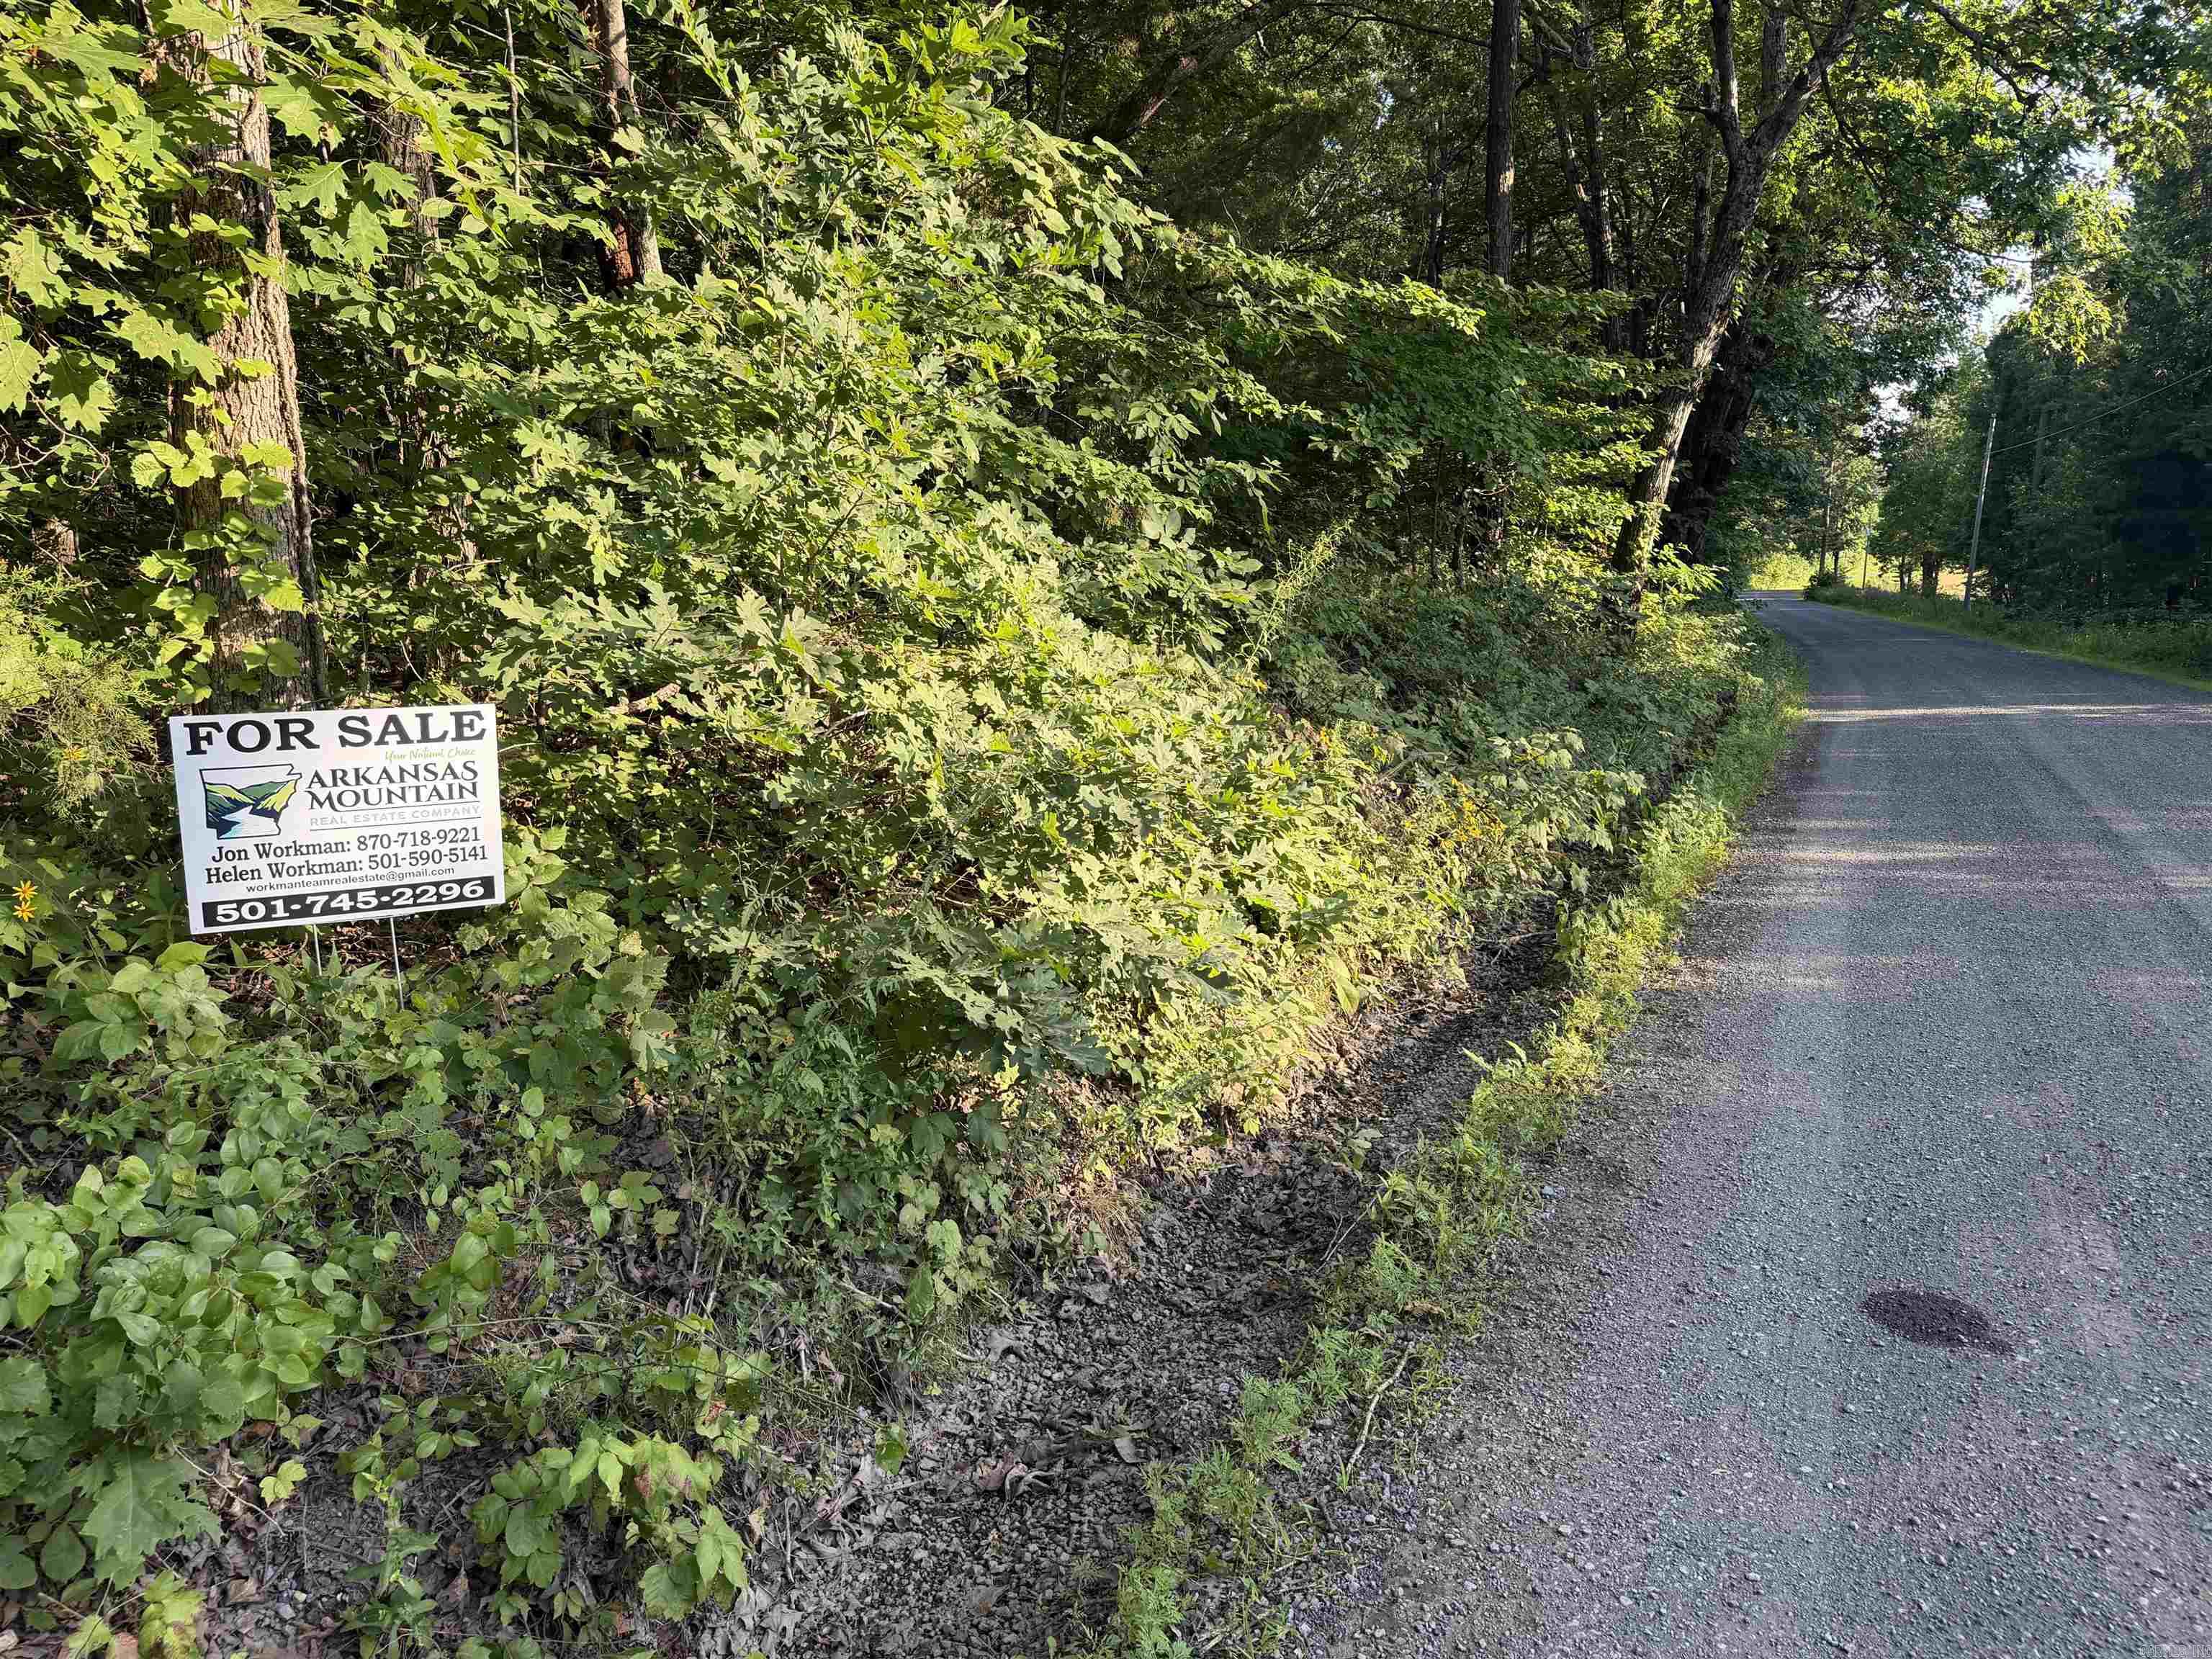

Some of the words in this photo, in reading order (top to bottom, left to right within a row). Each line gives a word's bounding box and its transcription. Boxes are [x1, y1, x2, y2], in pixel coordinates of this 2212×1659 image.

[184, 717, 320, 755] FOR
[338, 710, 487, 747] SALE
[385, 750, 407, 760] Your
[410, 748, 444, 760] Natural
[448, 747, 476, 758] Choice
[306, 761, 479, 789] ARKANSAS
[305, 781, 478, 811] MOUNTAIN
[310, 816, 347, 827] REAL
[354, 811, 407, 824] ESTATE
[412, 806, 480, 819] COMPANY
[212, 846, 250, 863] Jon
[254, 840, 351, 859] Workman:
[357, 827, 480, 850] 870-718-9221
[206, 863, 263, 884] Helen
[266, 857, 363, 878] Workman:
[369, 845, 487, 870] 501-590-5141
[246, 867, 454, 894] workmanteamrealestate@gmail.com
